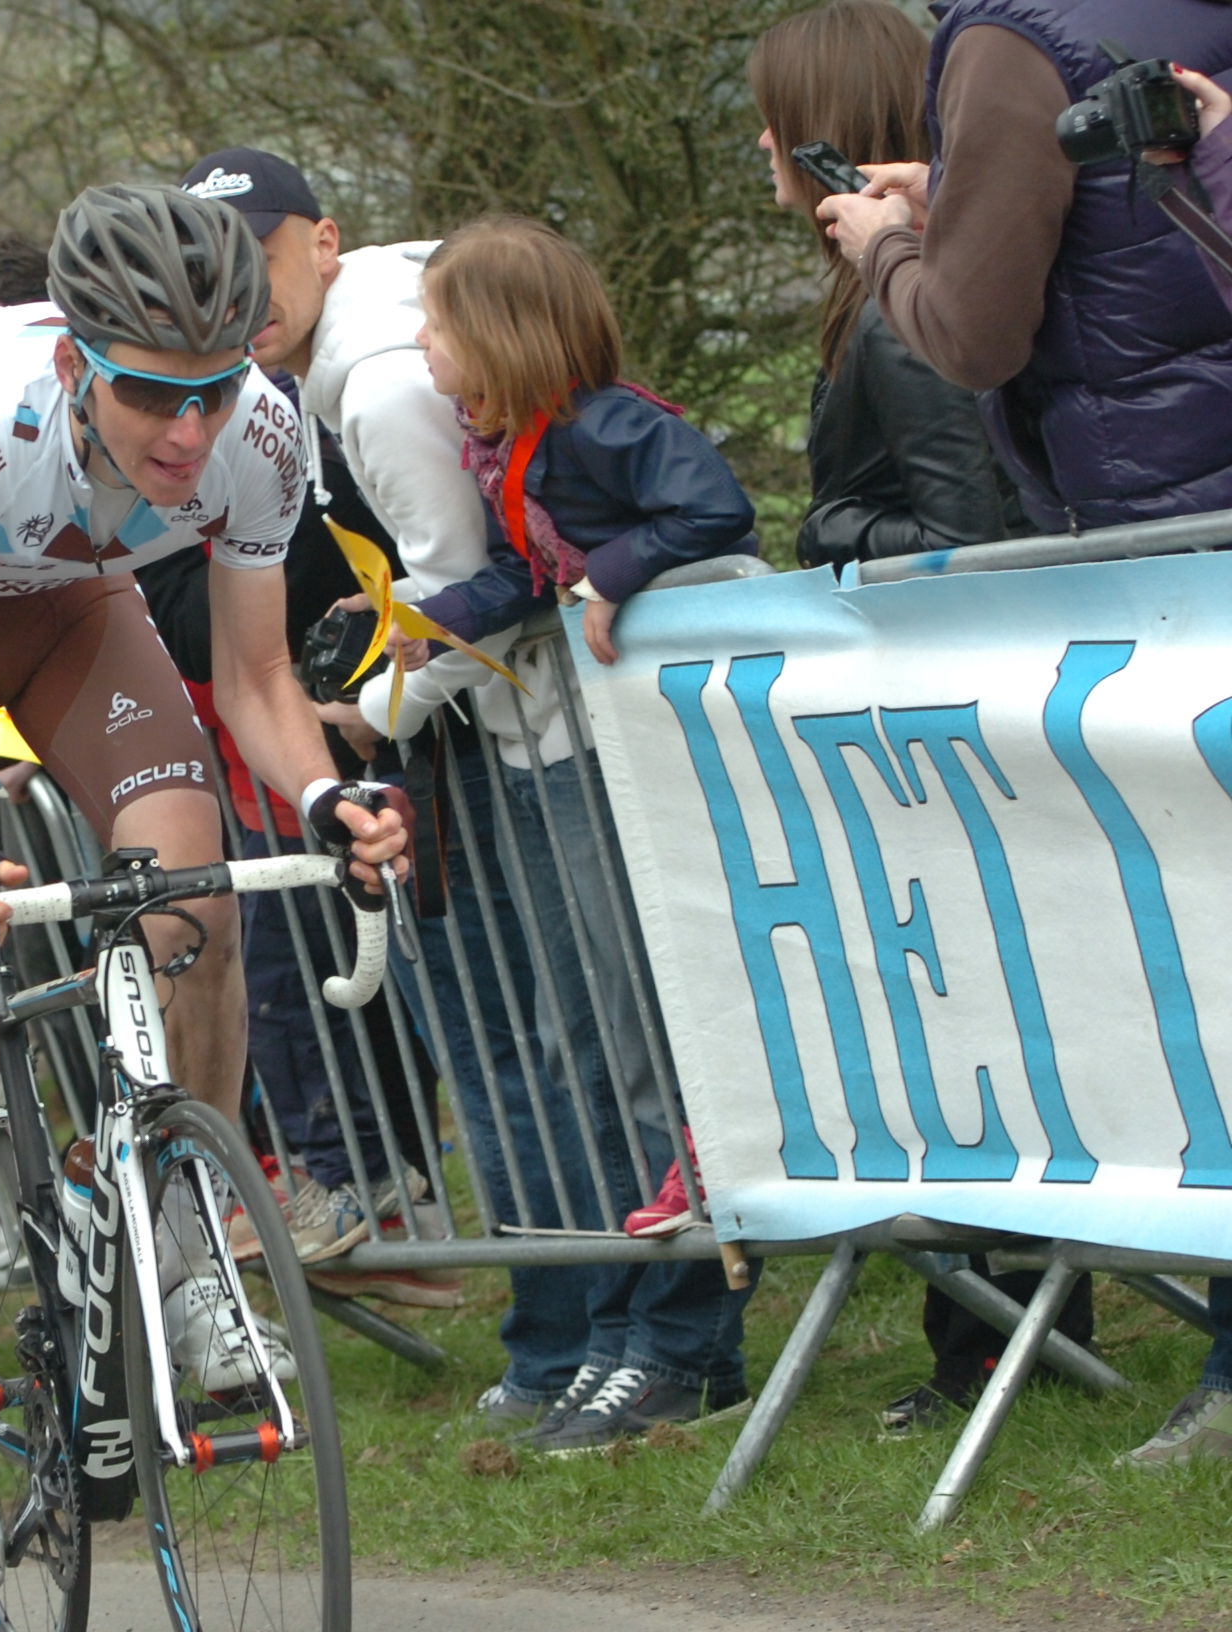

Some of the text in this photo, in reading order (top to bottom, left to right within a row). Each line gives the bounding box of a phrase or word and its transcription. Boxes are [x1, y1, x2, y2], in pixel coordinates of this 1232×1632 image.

[106, 709, 152, 734] odlo
[111, 762, 186, 804] FOCUS
[658, 651, 1099, 1183] HET
[119, 951, 158, 1081] FOCUS
[79, 1099, 119, 1407] FOCUS
